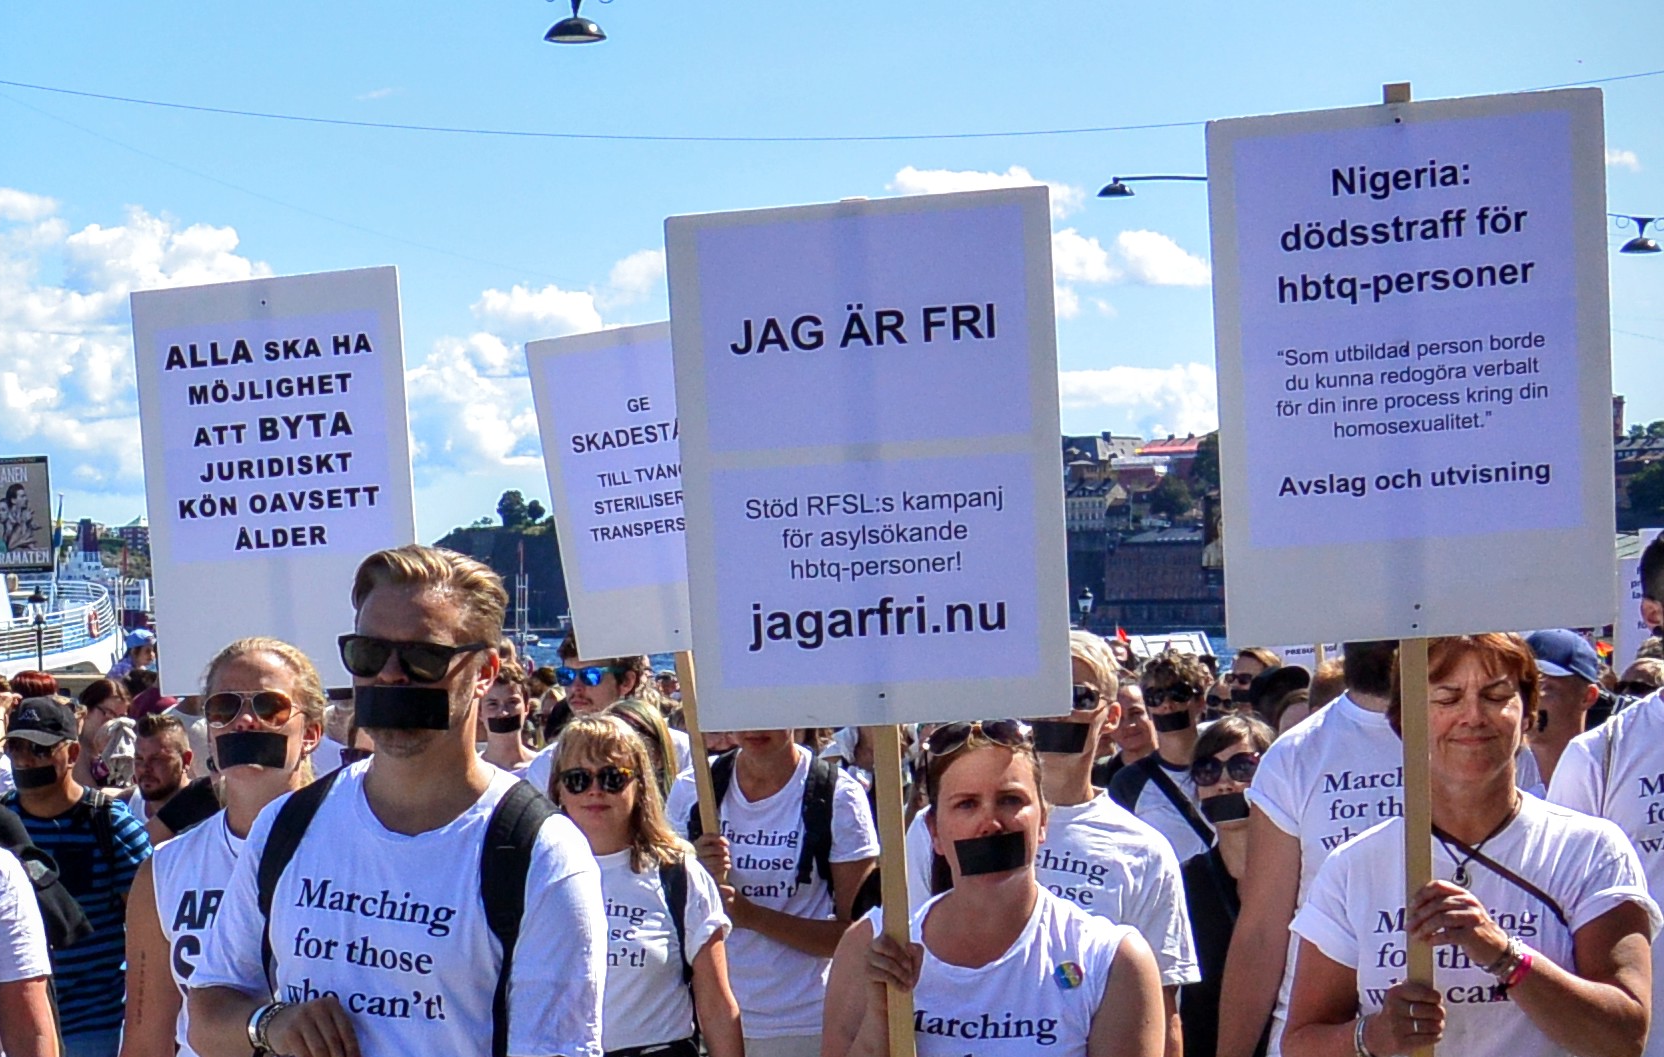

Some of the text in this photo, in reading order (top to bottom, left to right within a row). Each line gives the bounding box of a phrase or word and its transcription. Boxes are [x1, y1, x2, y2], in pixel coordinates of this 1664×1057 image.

[1330, 160, 1470, 200] Nigeria:
[1280, 205, 1528, 252] dödsstraff för
[1278, 261, 1536, 304] hbtq-personer
[730, 303, 996, 355] JAG ÄR FRI
[164, 333, 372, 370] ALLA SKA HA
[1335, 342, 1410, 364] utbildad
[1417, 338, 1484, 360] person
[1490, 332, 1546, 351] borde
[188, 372, 352, 406] MÖJLIGHET
[1285, 358, 1540, 392] du kunna redogöra verbalt
[627, 397, 650, 412] GE
[1276, 382, 1548, 417] för din inre process kring din
[194, 412, 352, 447] ATT BYTA
[200, 452, 353, 483] JURIDISKT
[597, 471, 631, 487] TILL
[1279, 462, 1551, 498] Avslag och utvisning
[178, 486, 380, 519] KÖN OAVSETT
[746, 487, 1004, 520] Stöd RFSL:s kampanj
[235, 526, 327, 550] ÅLDER
[782, 522, 968, 552] för asylsökande
[790, 552, 962, 582] hbtq-personer!
[749, 596, 1006, 652] jagarfri.nu
[1330, 799, 1368, 820] for
[736, 854, 794, 870] those
[295, 878, 456, 936] Marching
[294, 927, 432, 974] for those
[348, 991, 445, 1020] can’t!
